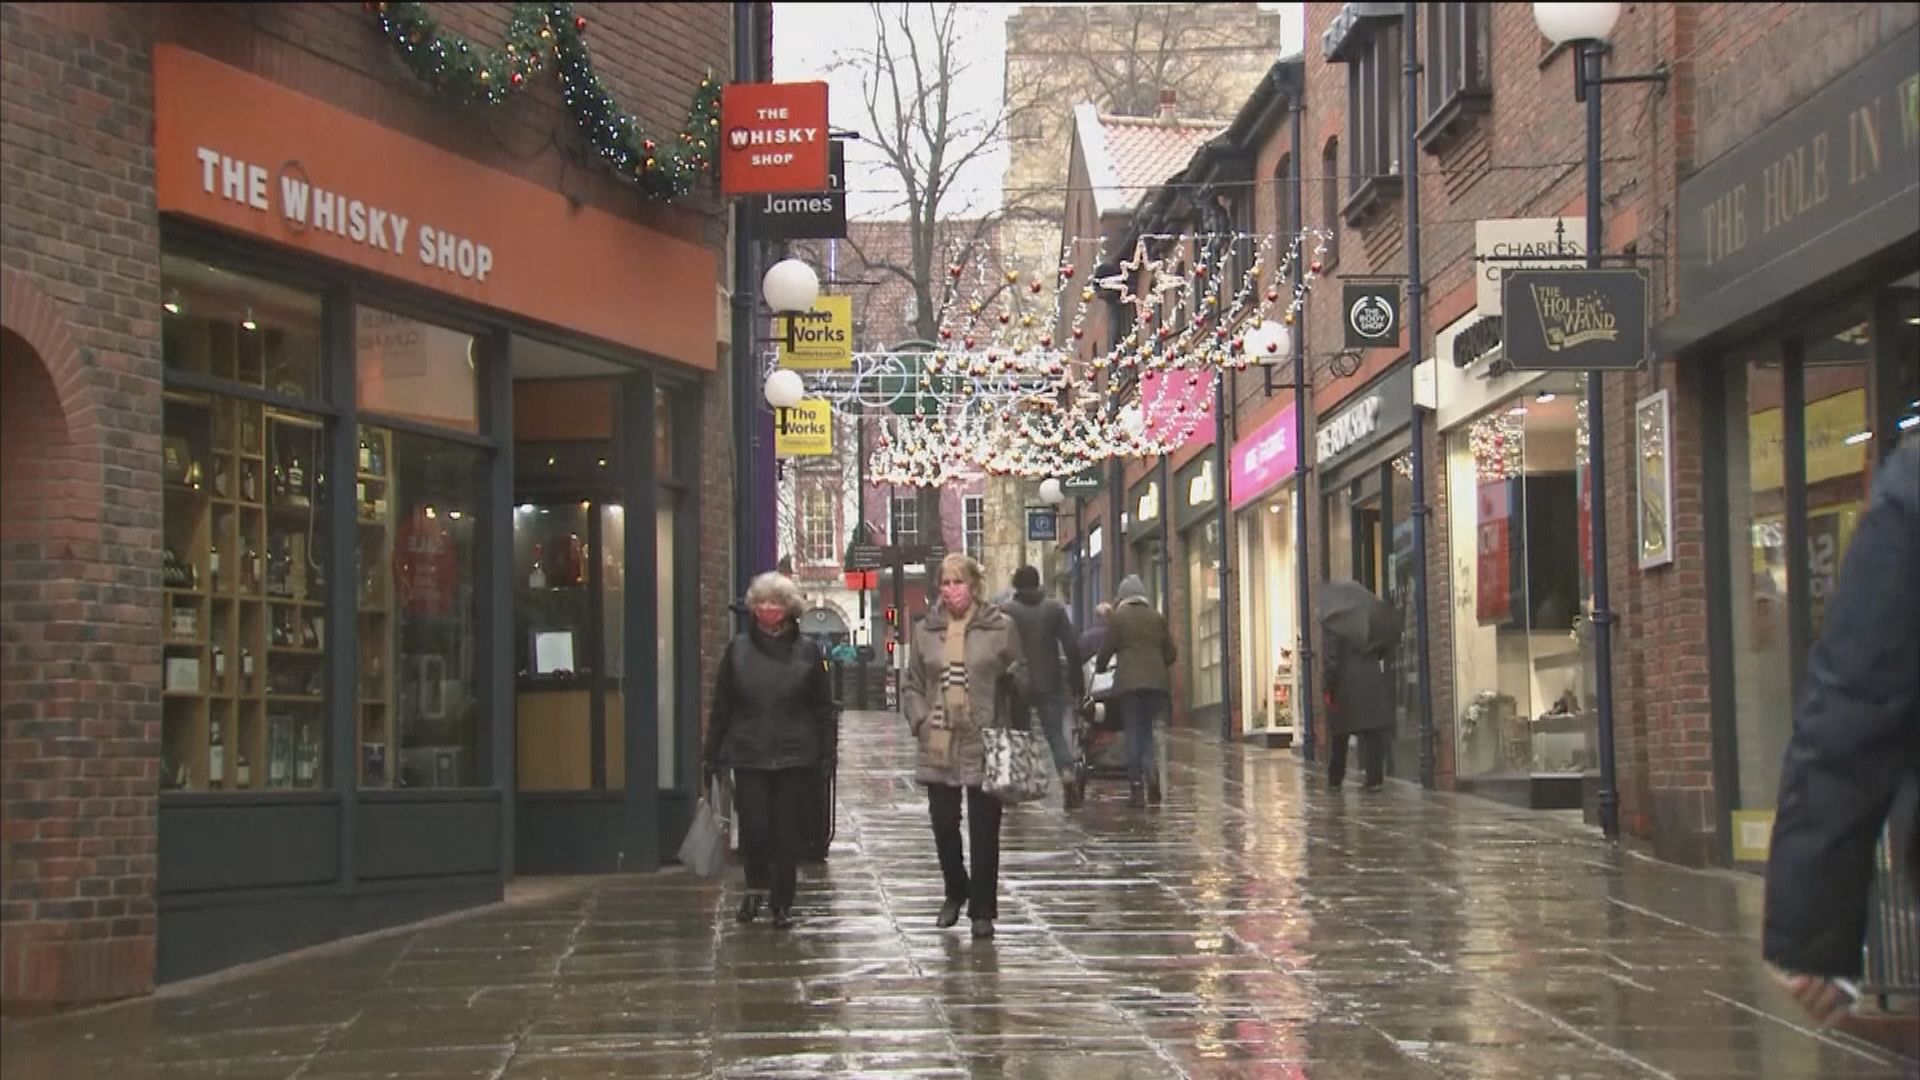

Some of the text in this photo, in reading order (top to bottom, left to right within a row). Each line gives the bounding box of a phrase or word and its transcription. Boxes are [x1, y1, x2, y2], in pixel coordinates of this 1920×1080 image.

[757, 108, 788, 119] THE
[731, 128, 817, 145] WHISKY
[752, 154, 793, 165] SHOP
[1704, 183, 1746, 266] THE
[1763, 131, 1829, 233] HOLE
[1849, 96, 1881, 184] IN
[763, 194, 832, 213] James
[197, 147, 493, 282] THE WHISKY SHOP
[1543, 298, 1585, 317] HOLE
[1563, 312, 1615, 333] WAND
[792, 408, 816, 419] The
